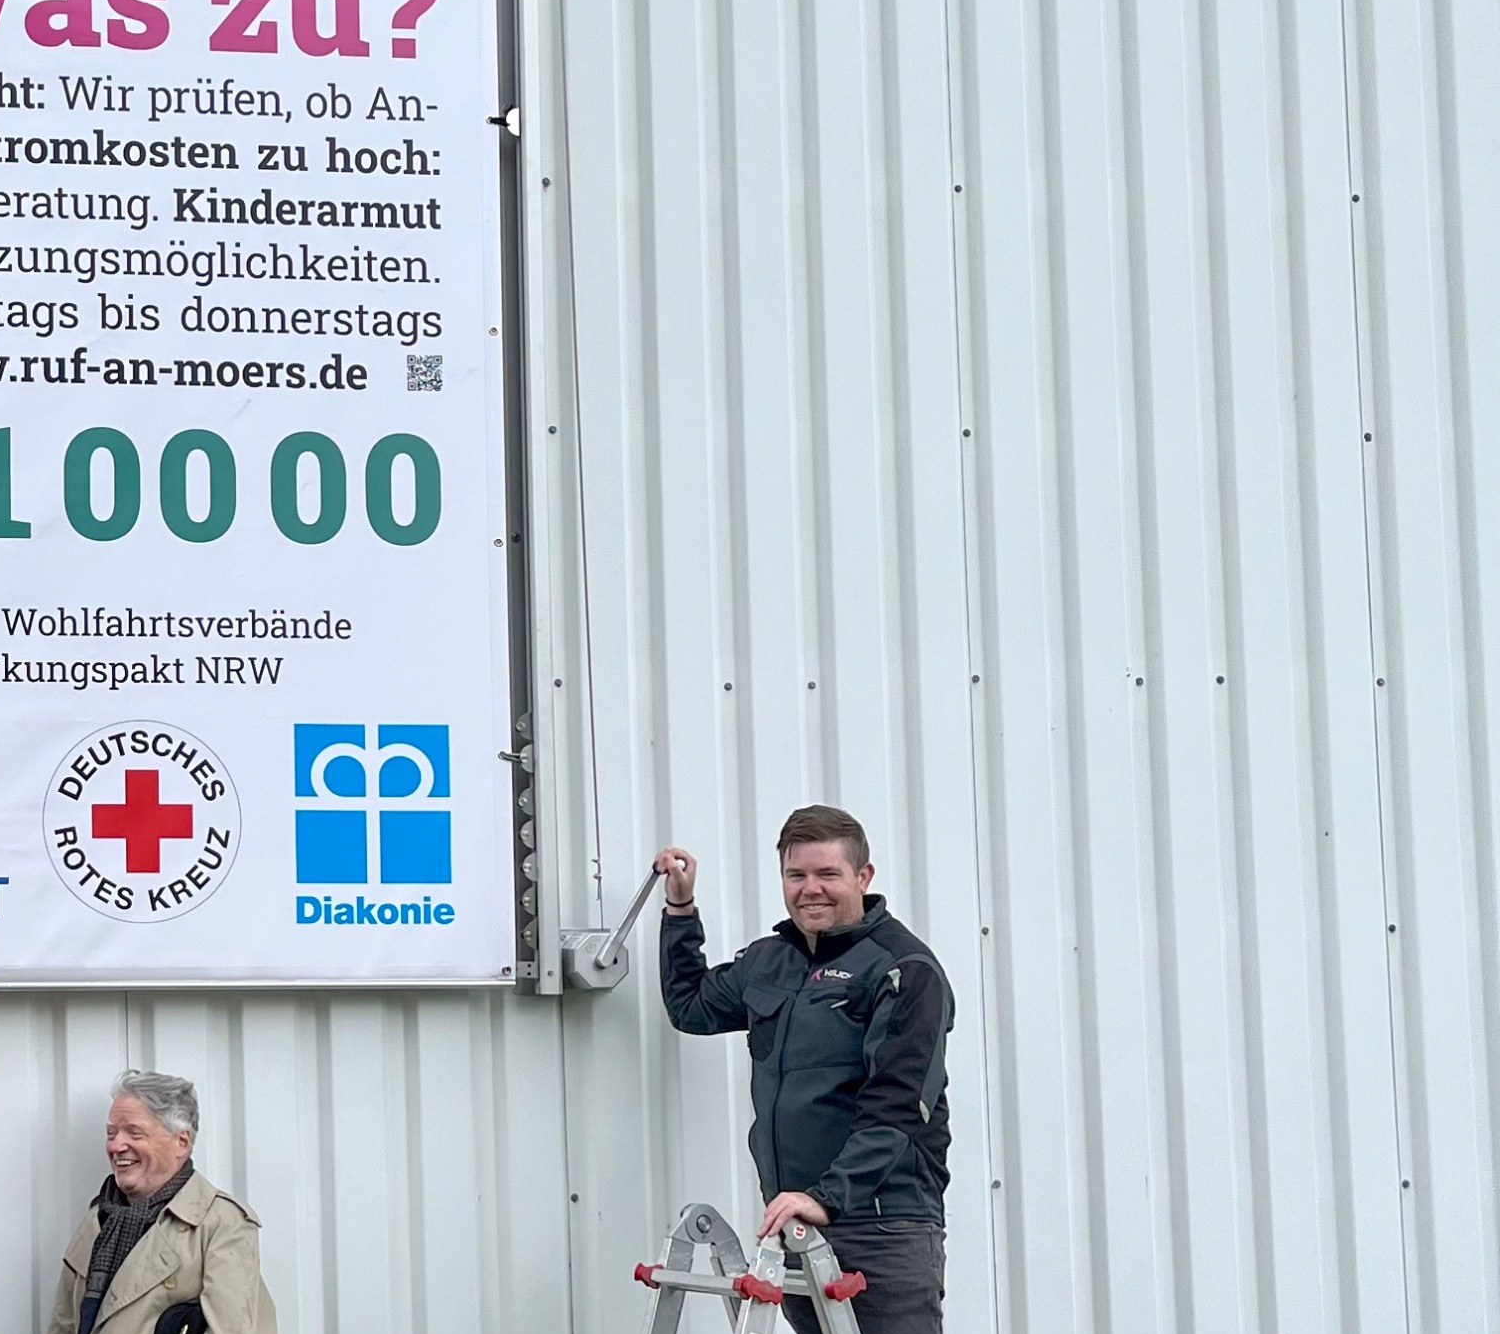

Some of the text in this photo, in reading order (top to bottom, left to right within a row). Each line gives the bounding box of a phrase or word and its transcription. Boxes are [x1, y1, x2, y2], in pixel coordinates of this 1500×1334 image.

[59, 75, 134, 111] Wir
[148, 78, 291, 123] prüfen,
[307, 83, 351, 119] ob
[366, 87, 437, 121] An-
[258, 145, 308, 171] zu
[326, 137, 440, 175] hoch:
[173, 187, 441, 229] Kinderarmut
[98, 293, 159, 330] bis
[181, 296, 441, 346] donnerstags
[64, 427, 236, 543] 00
[271, 431, 441, 546] 00
[1, 607, 351, 639] Wohlfahrtsverbände
[195, 657, 283, 684] NRW
[58, 730, 225, 801] DEUTSCHES
[55, 826, 230, 911] ROTES KREUZ
[296, 896, 455, 925] Diakonie
